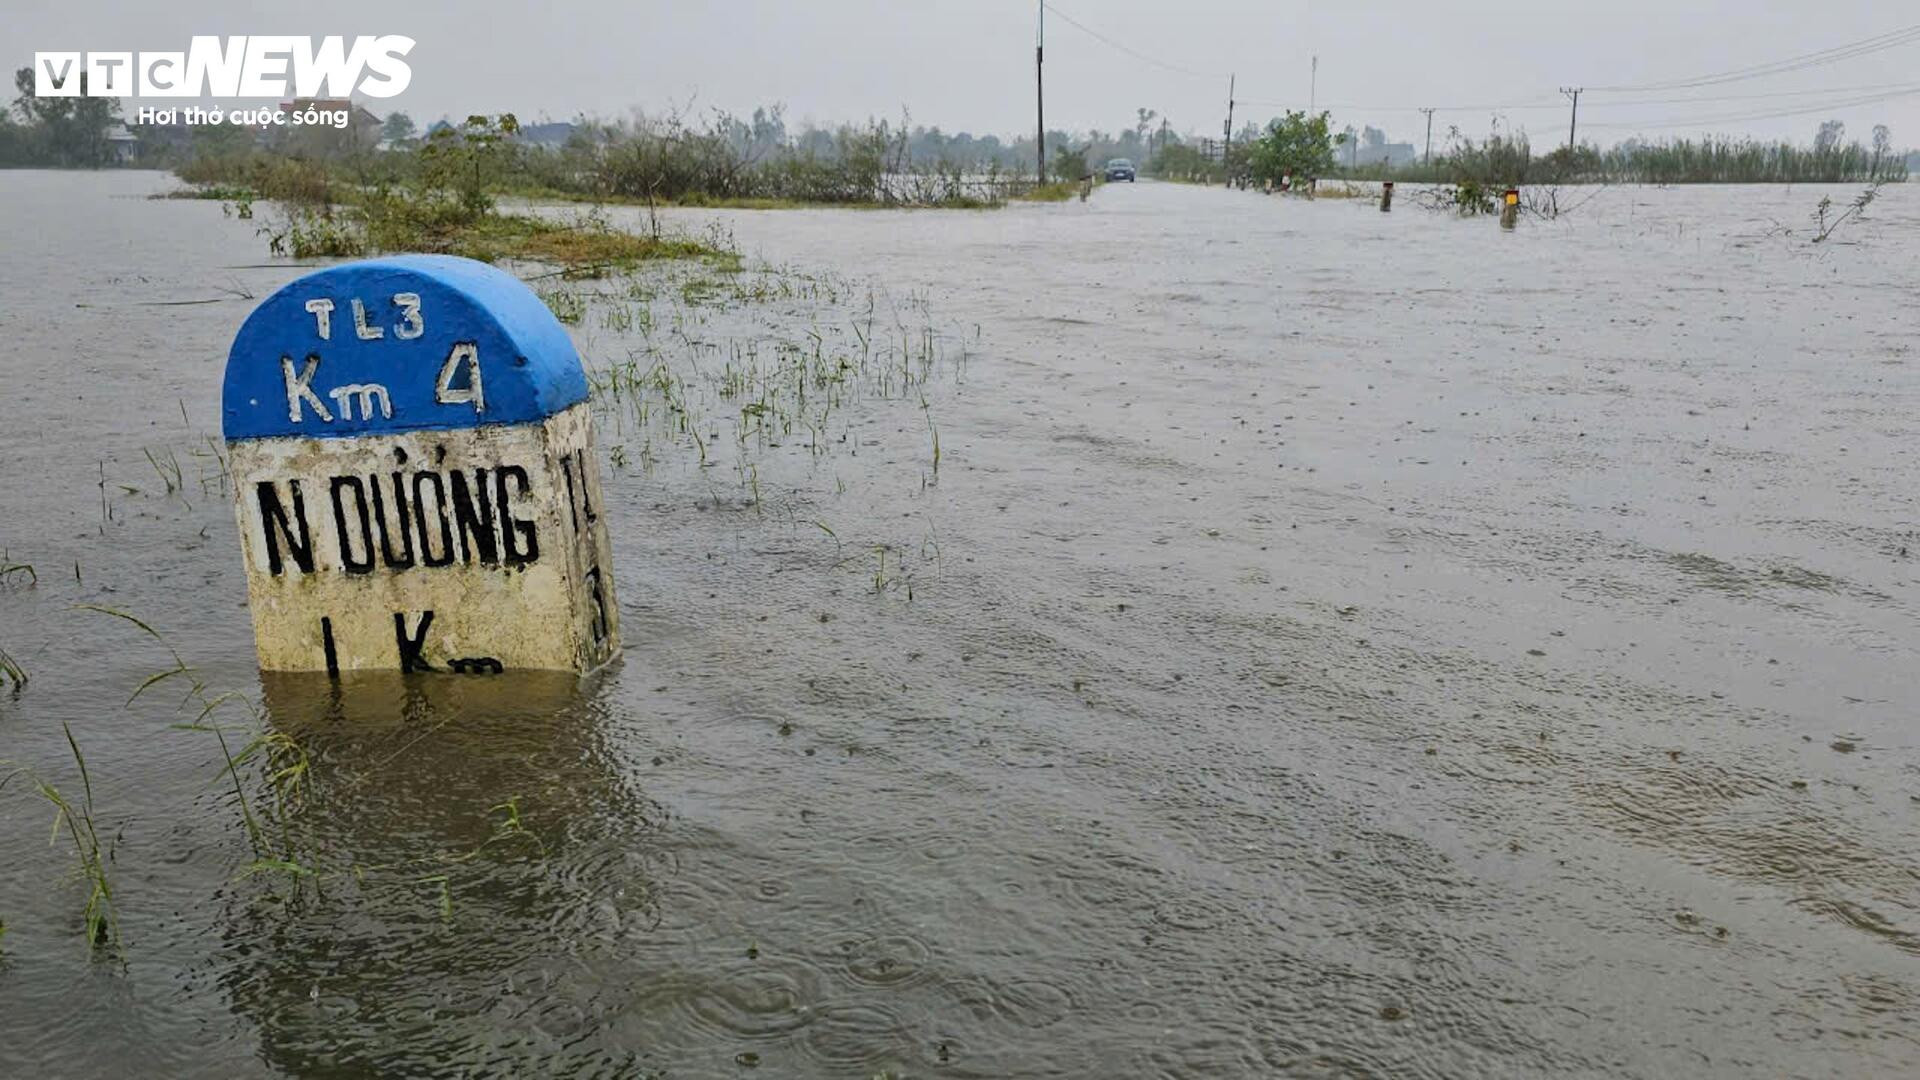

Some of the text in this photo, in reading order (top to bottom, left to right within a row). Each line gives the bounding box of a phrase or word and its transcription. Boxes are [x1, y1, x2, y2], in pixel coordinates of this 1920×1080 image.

[281, 342, 485, 423] Km 4
[257, 479, 315, 577] N
